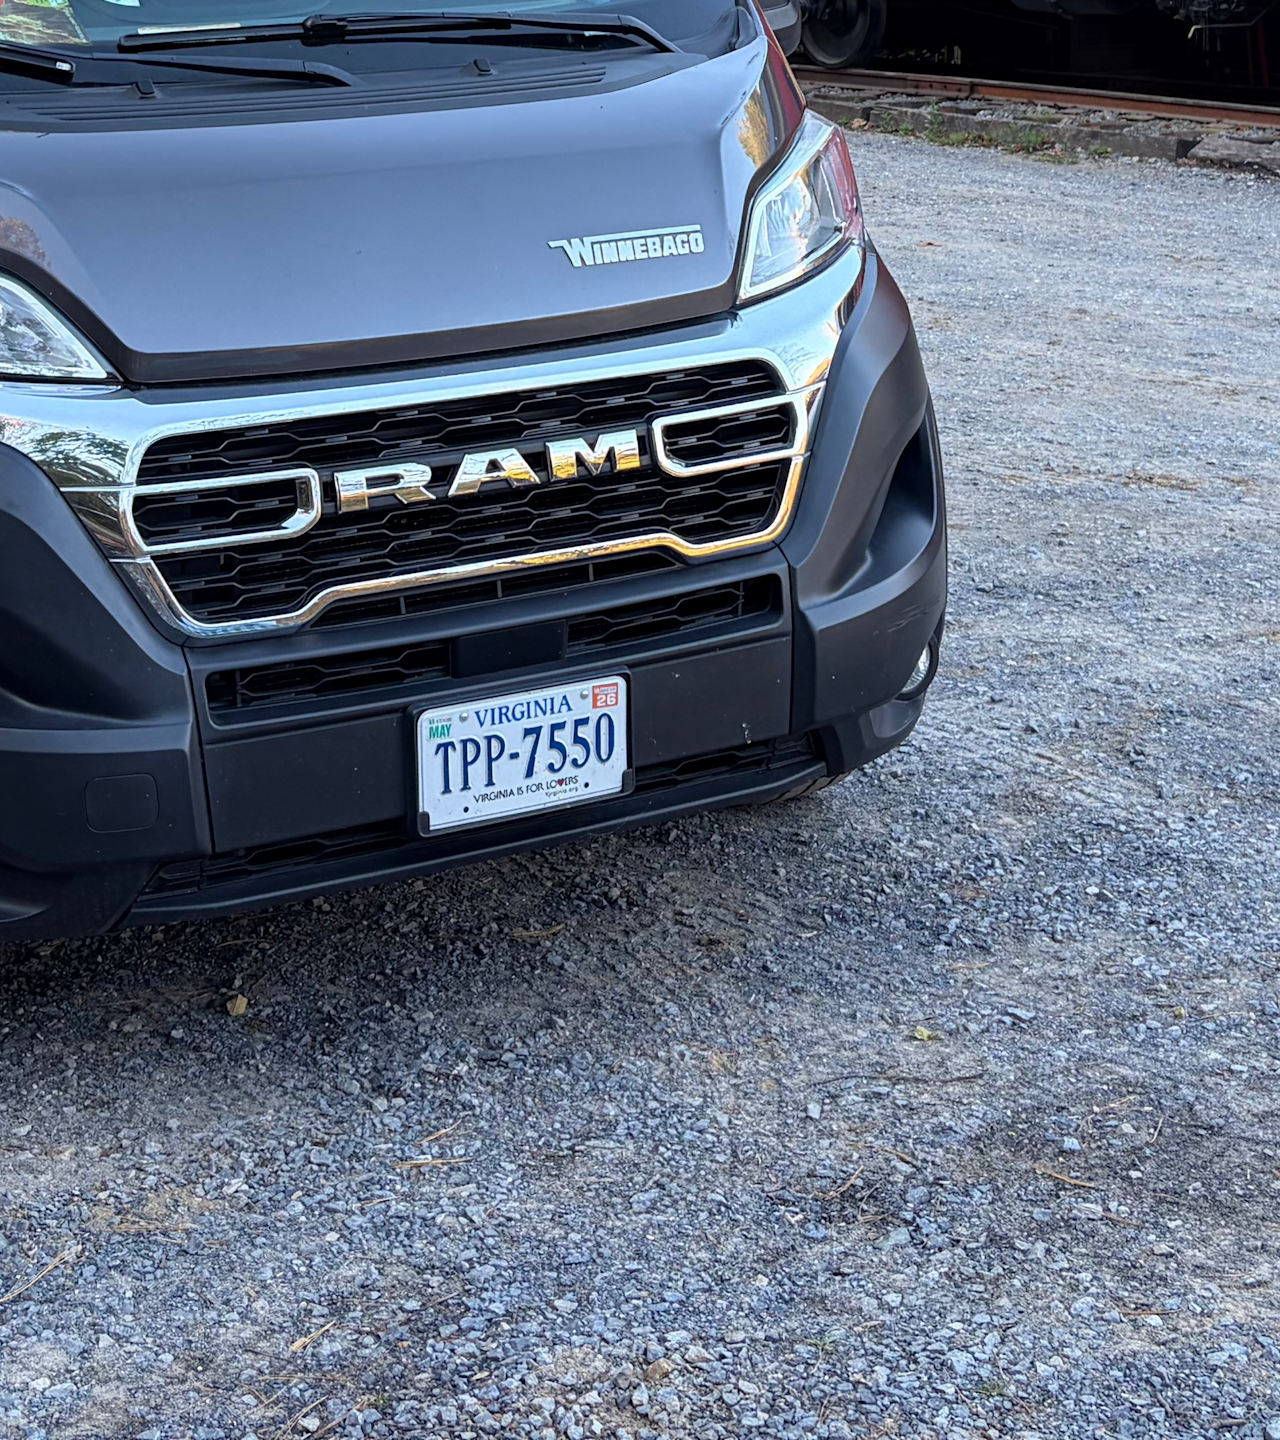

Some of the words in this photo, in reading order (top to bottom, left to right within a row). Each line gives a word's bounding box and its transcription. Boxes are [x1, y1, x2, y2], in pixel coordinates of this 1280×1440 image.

[547, 224, 705, 268] WINNEBAGO
[334, 429, 641, 513] RAM
[474, 694, 573, 728] VIRGINIA
[596, 693, 616, 707] 26
[429, 724, 452, 739] MAY
[434, 712, 615, 795] TPP-7550
[473, 788, 515, 804] VIRGINIA
[517, 786, 524, 796] IS
[526, 782, 544, 794] FOR
